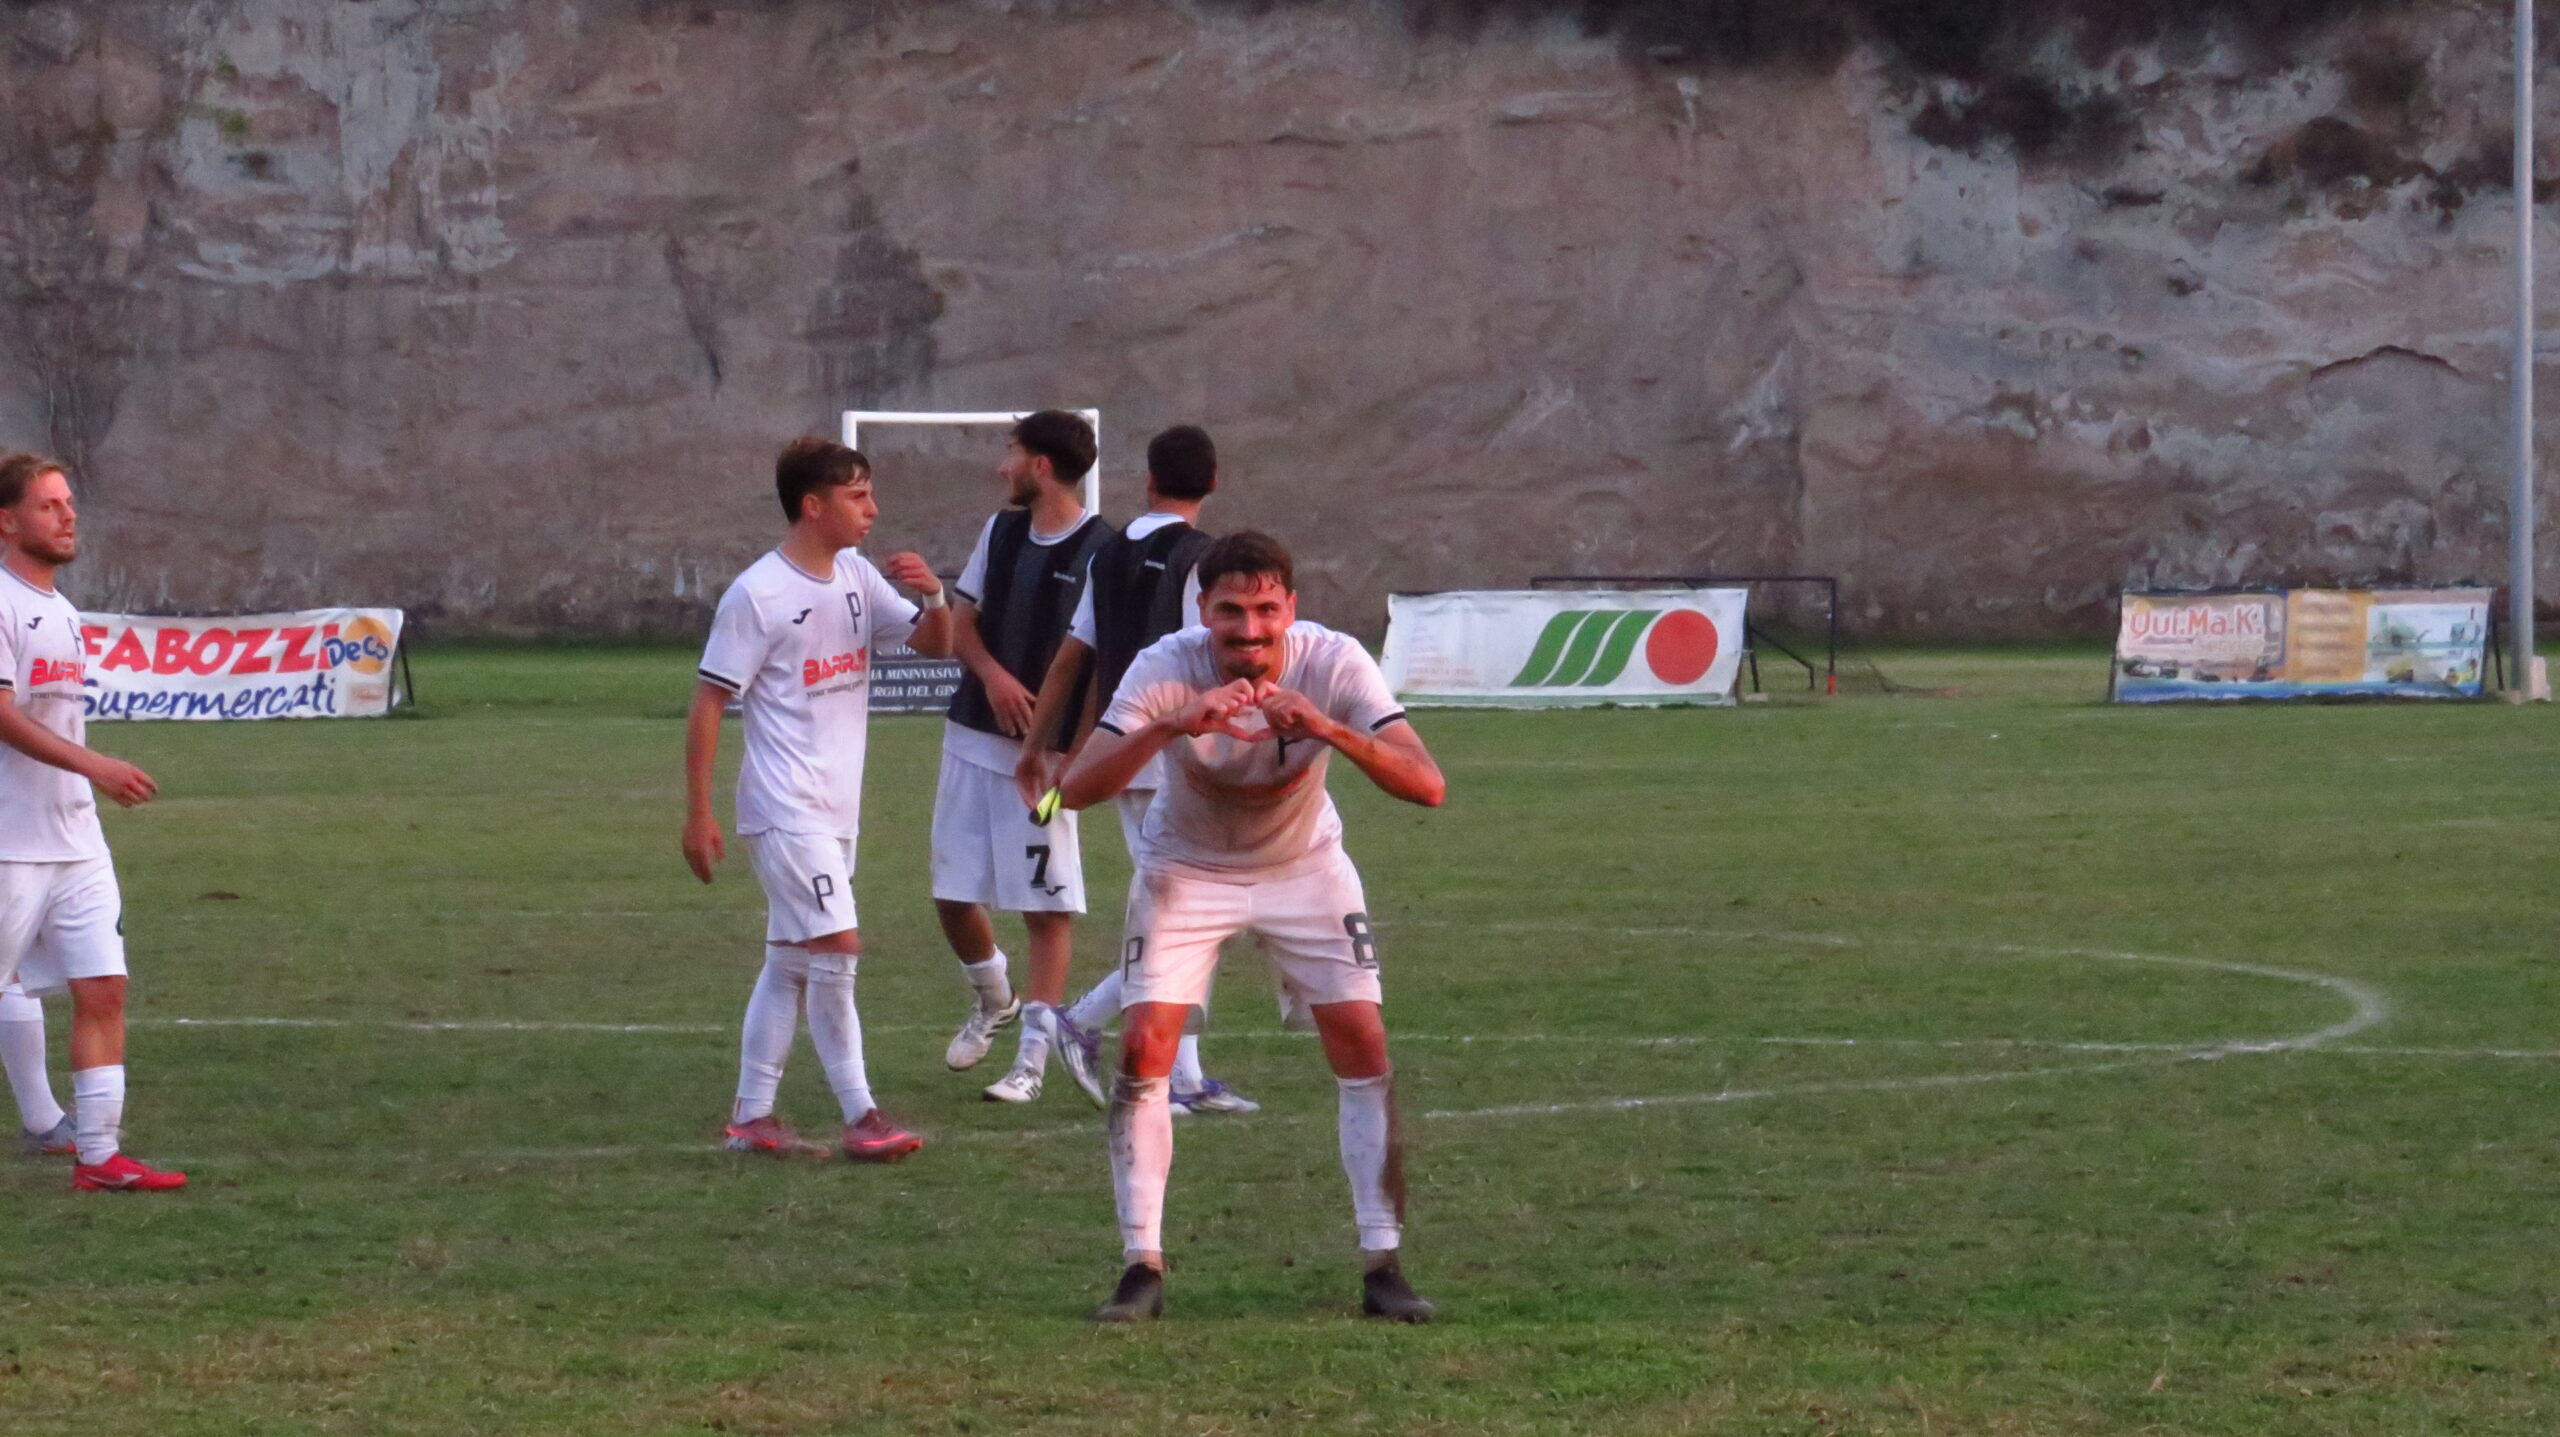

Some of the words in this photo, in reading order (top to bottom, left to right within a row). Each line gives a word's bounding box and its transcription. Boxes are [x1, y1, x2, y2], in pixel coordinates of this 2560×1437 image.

[846, 591, 861, 634] P
[80, 623, 339, 675] FABOZZI
[82, 671, 336, 717] Supermercati
[886, 667, 962, 680] MININVASIVA
[907, 685, 932, 697] DEL
[1026, 845, 1051, 888] 7
[812, 874, 834, 912] P
[1124, 935, 1144, 982] P
[1343, 911, 1379, 969] 8
